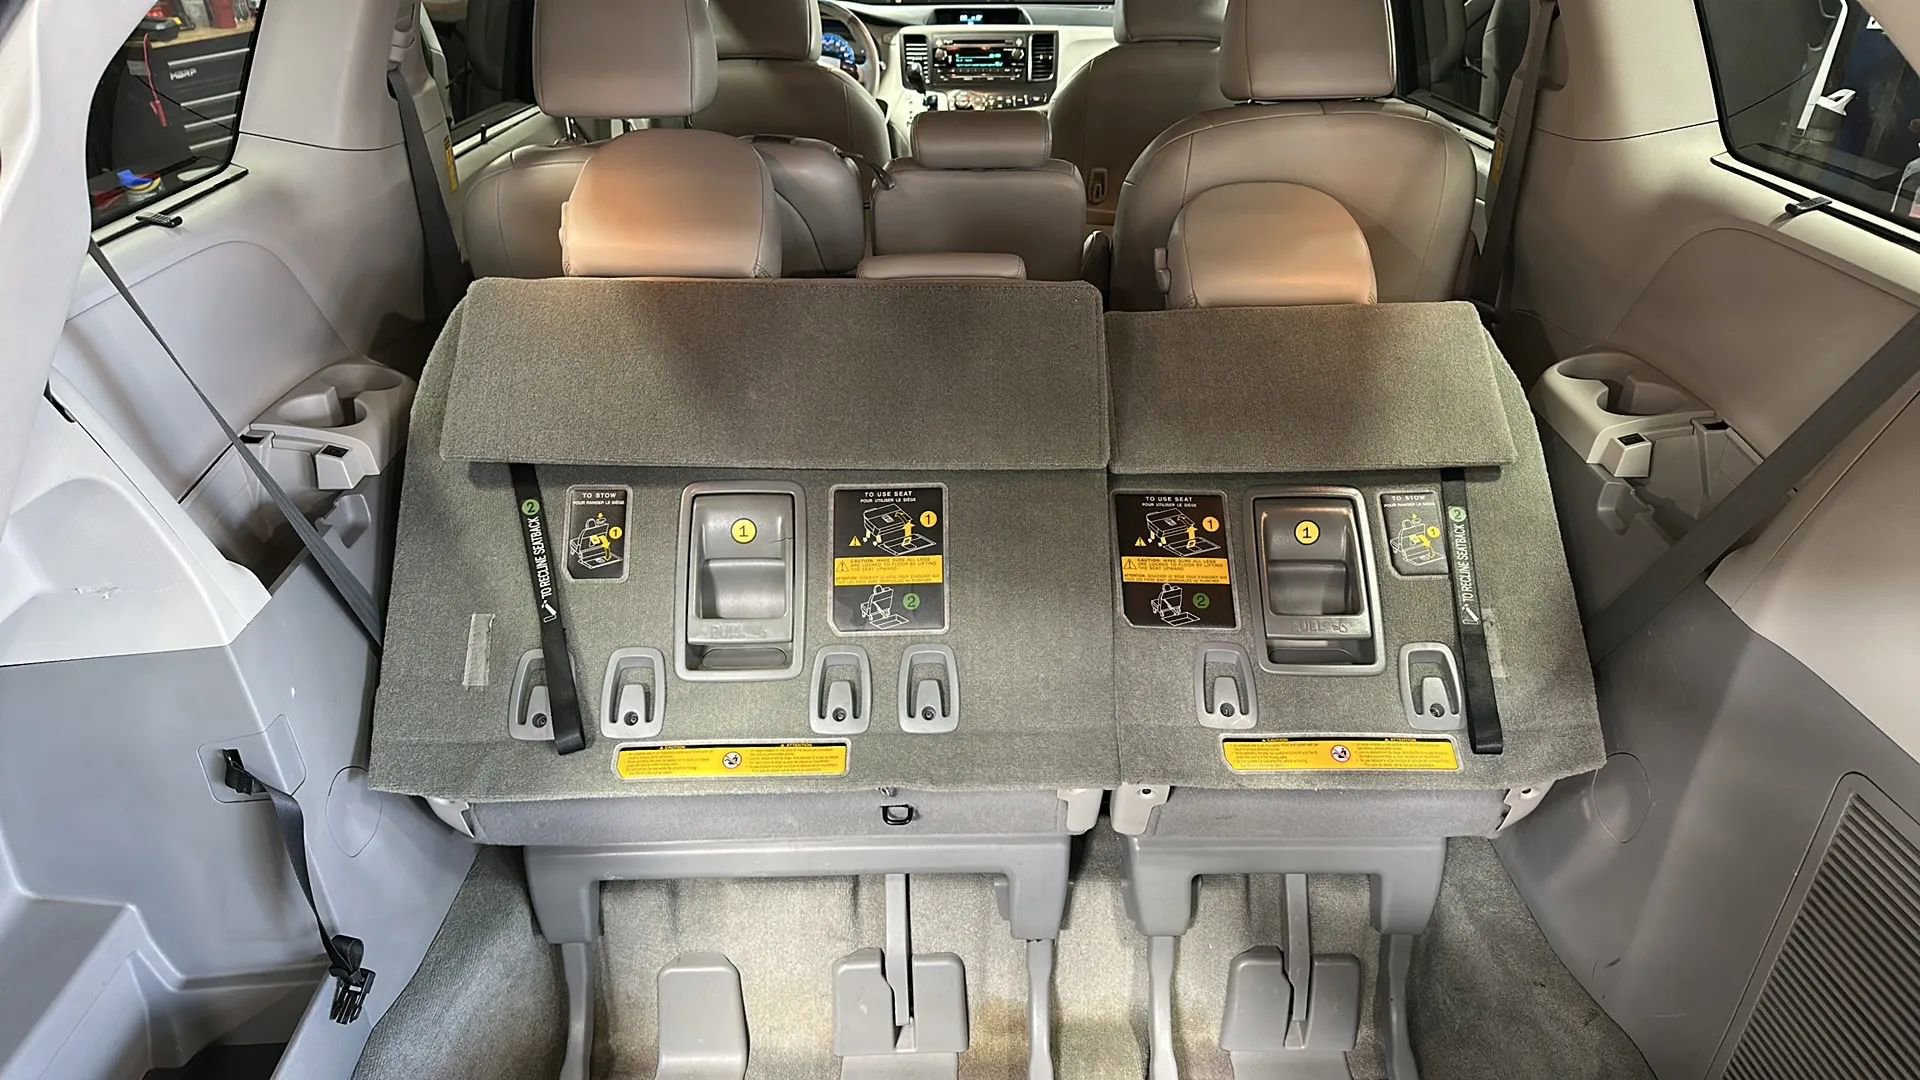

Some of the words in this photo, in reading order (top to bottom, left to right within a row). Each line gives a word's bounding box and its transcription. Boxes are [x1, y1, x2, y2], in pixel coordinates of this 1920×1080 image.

[527, 502, 536, 513] 2
[1454, 509, 1461, 519] 2
[527, 516, 545, 555] SEATBACK
[738, 525, 748, 538] 1
[1302, 528, 1312, 538] 1
[1454, 524, 1469, 560] SEATBACK
[534, 555, 550, 587] RECLINE
[1458, 562, 1472, 592] RECLINE
[540, 587, 552, 599] TO
[1462, 592, 1474, 602] TO
[908, 596, 915, 607] 2
[1197, 595, 1205, 606] 2
